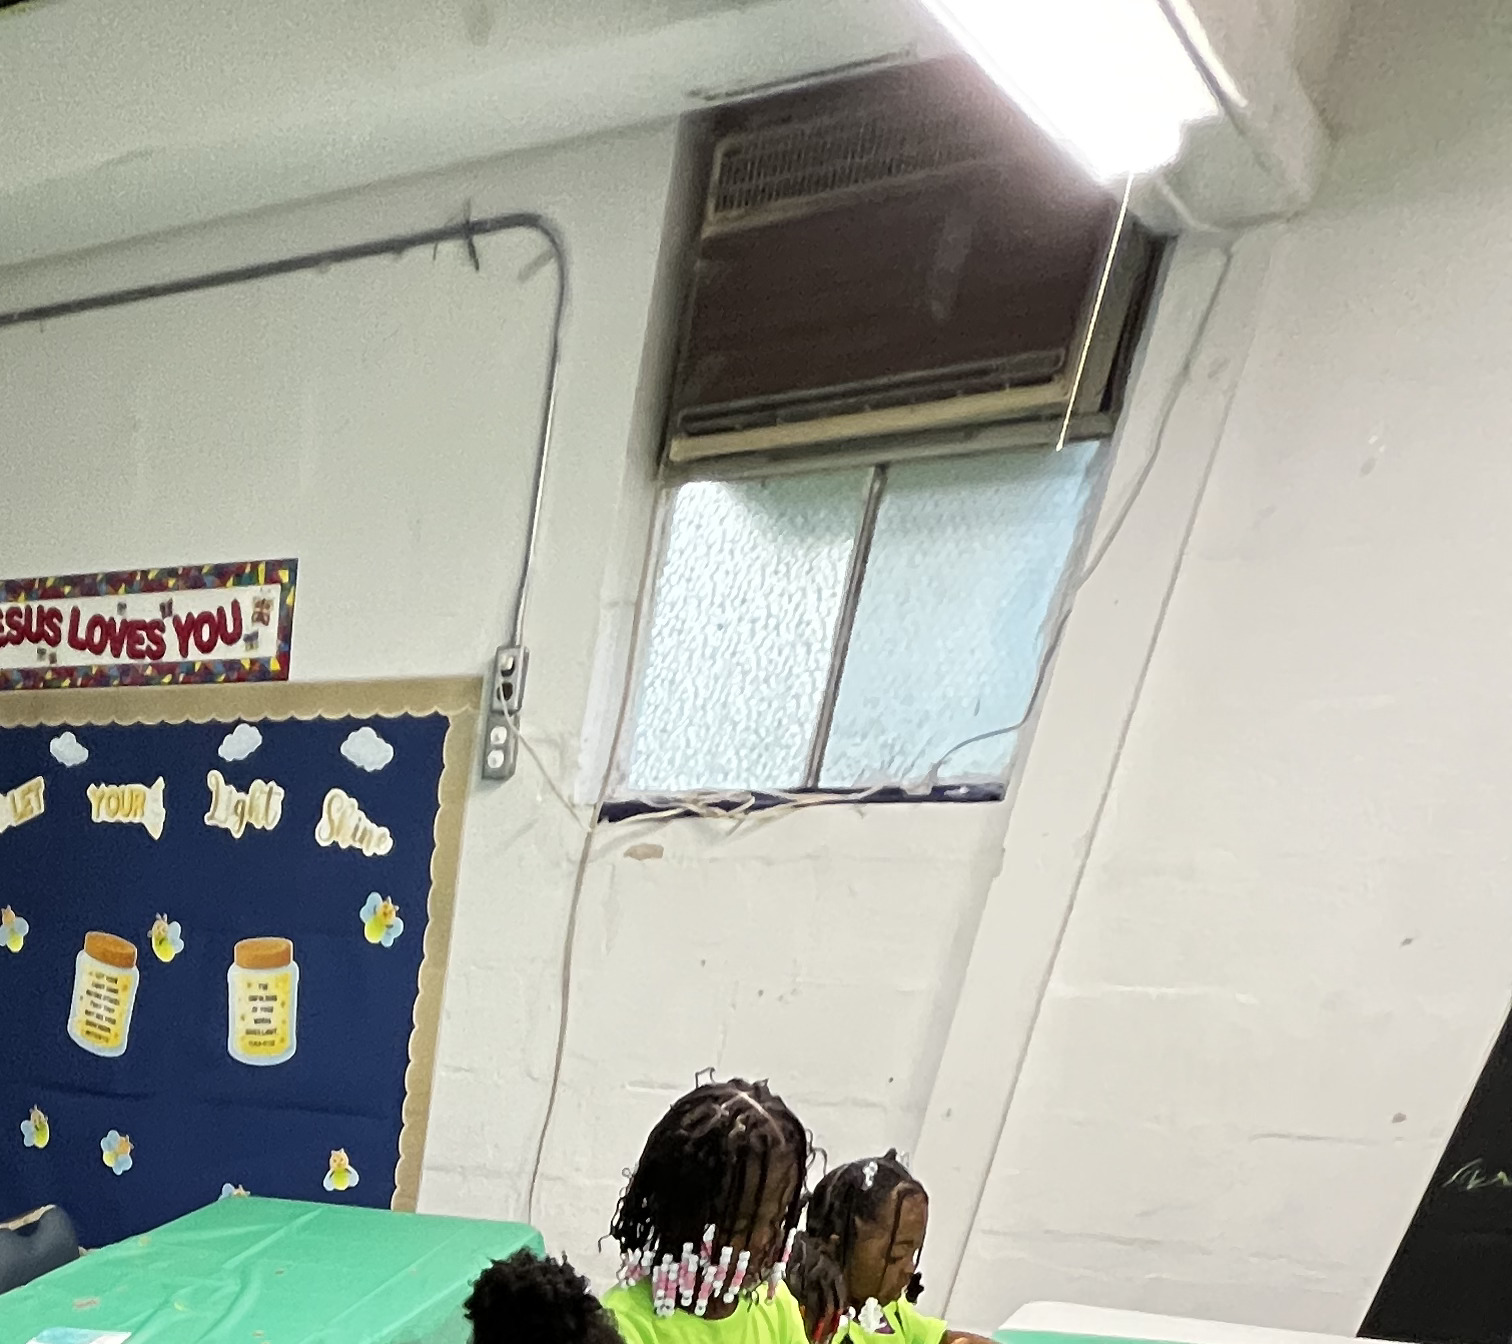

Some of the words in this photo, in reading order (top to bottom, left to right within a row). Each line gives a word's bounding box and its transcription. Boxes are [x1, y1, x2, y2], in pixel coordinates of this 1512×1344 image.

[68, 606, 167, 662] LOVES
[169, 598, 244, 659] YOU
[90, 785, 149, 821] YOUR
